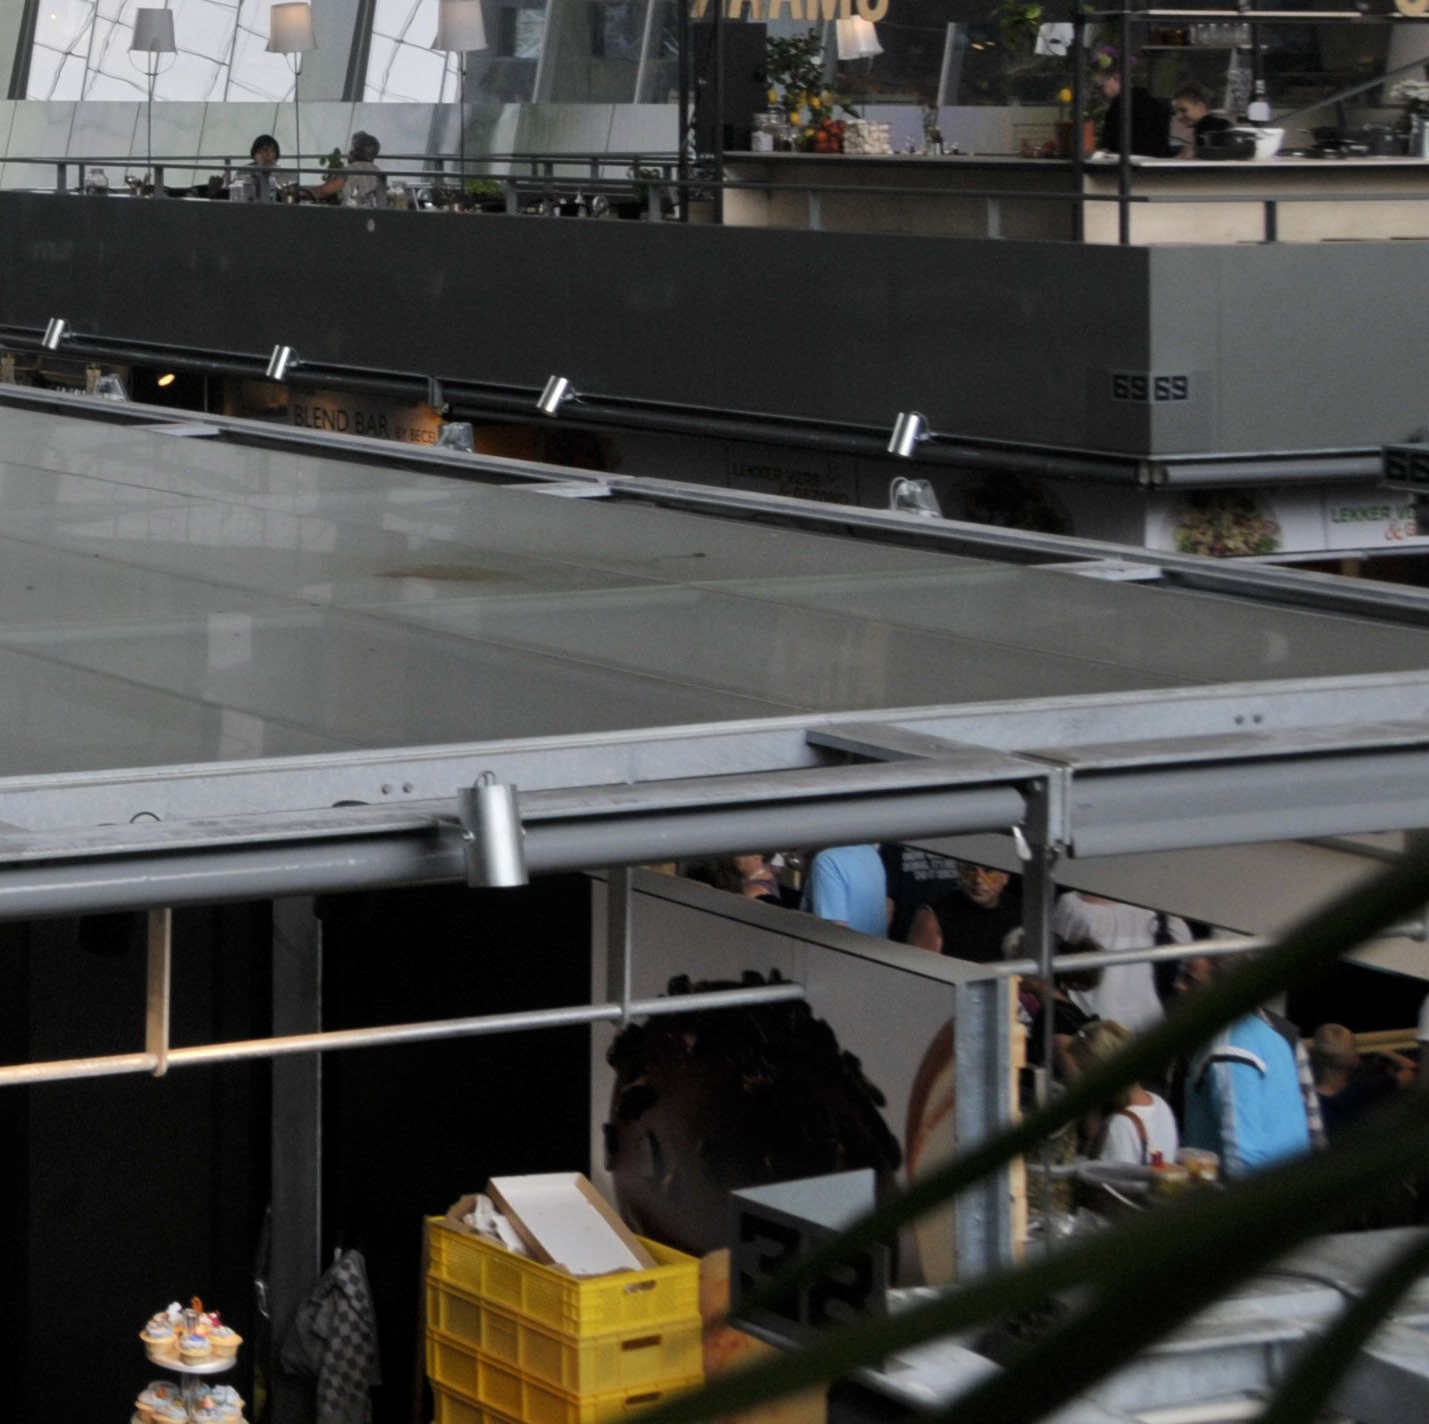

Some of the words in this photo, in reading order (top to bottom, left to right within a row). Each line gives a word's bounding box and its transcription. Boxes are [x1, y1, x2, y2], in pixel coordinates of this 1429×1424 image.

[294, 405, 349, 433] BLEND
[356, 412, 389, 437] BAR
[1331, 506, 1389, 523] LEKKER
